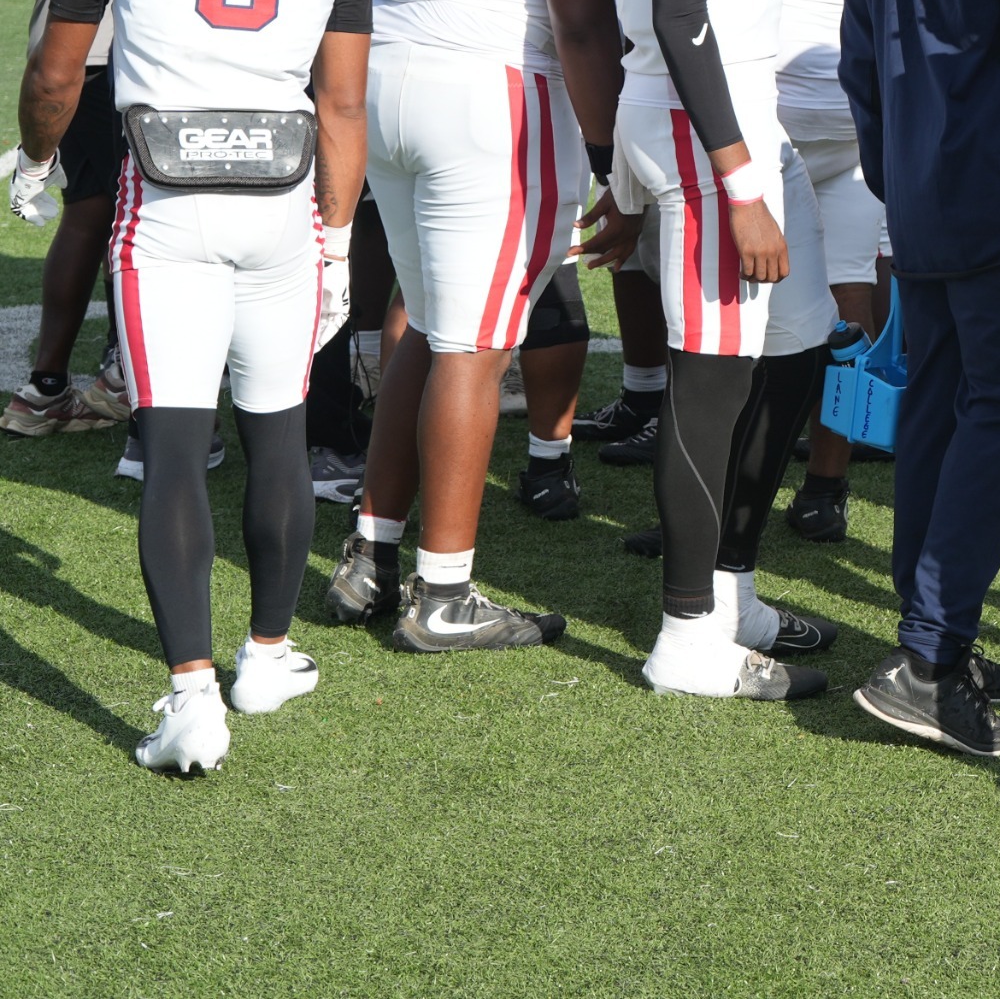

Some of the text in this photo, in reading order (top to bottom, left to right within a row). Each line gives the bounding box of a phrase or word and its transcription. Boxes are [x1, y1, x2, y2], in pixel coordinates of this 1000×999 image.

[178, 128, 273, 149] GEAR
[832, 372, 842, 417] LANE
[861, 379, 874, 439] COLLEGE
